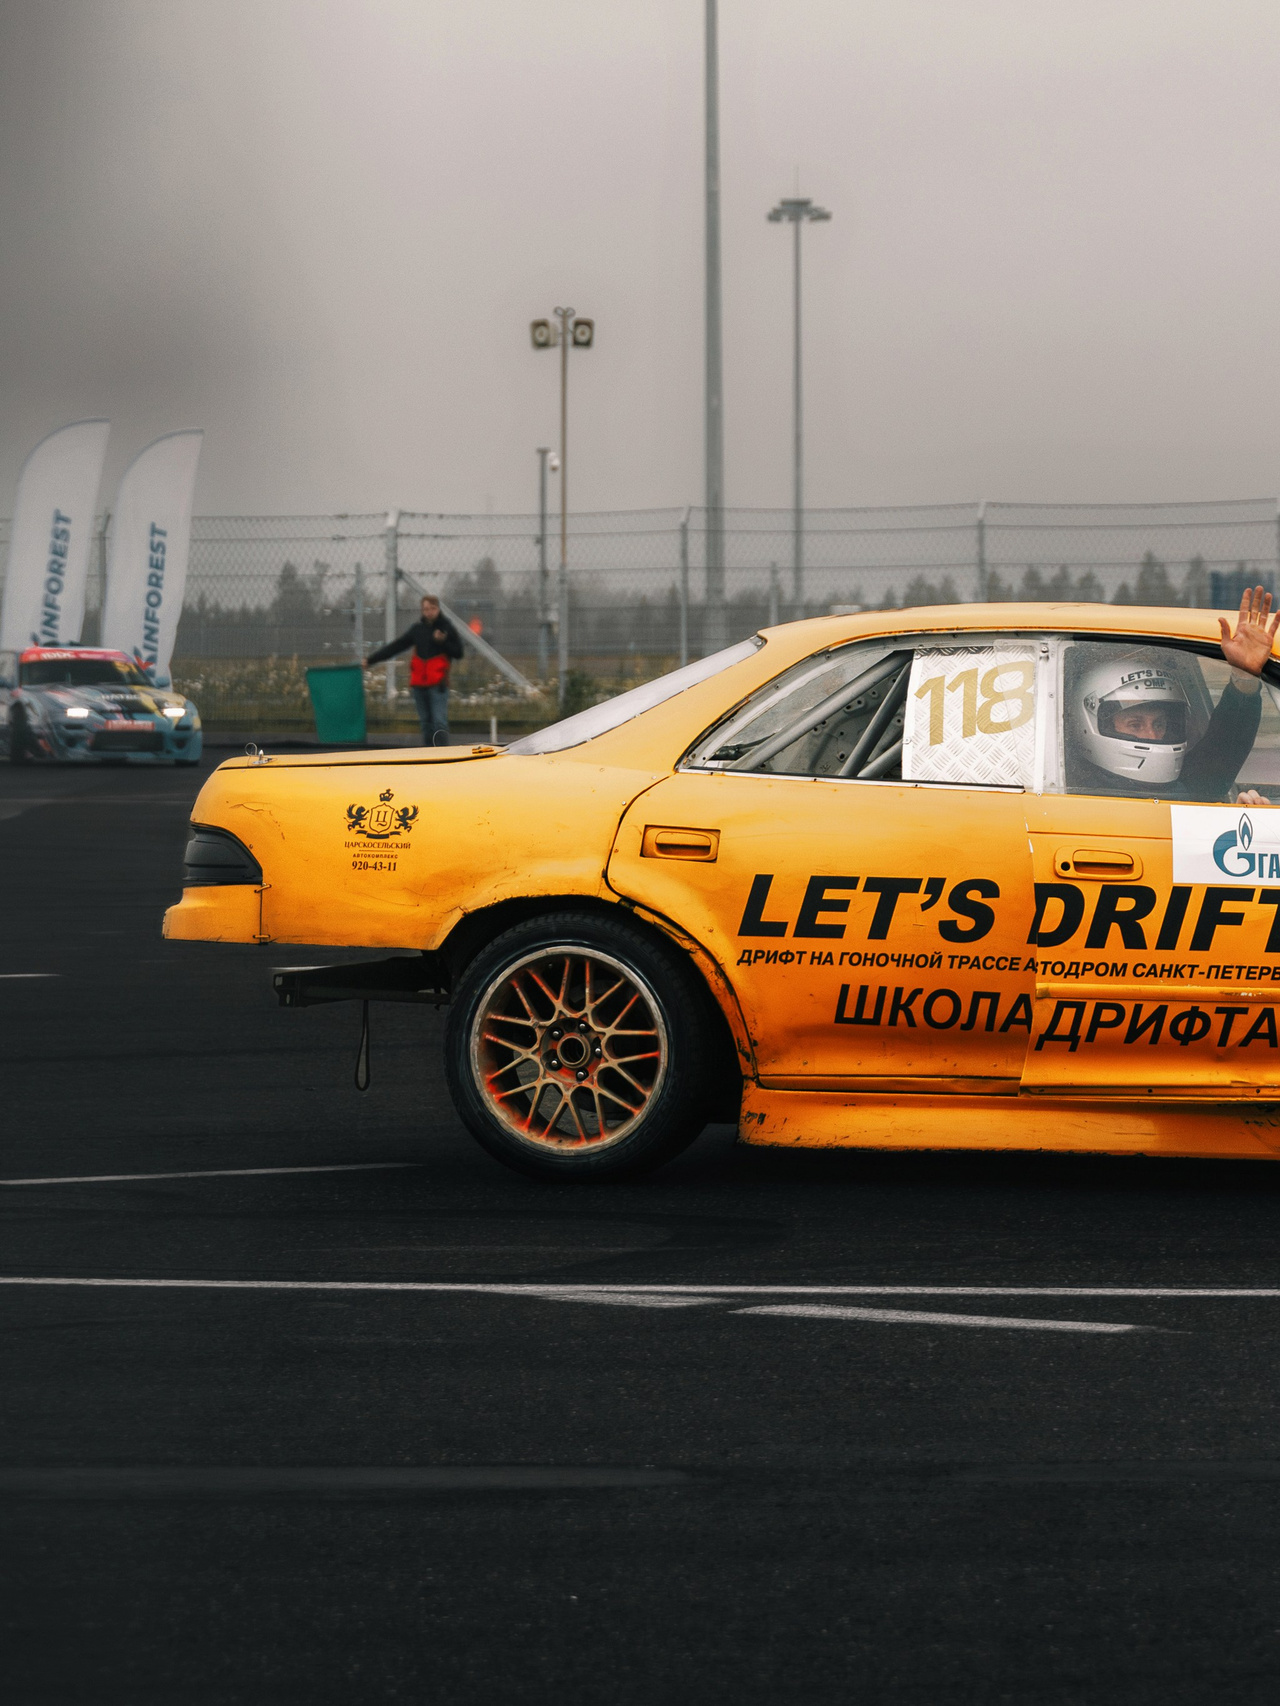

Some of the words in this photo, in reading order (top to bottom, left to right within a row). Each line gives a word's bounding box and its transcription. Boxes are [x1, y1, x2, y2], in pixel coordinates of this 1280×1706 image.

[1121, 669, 1153, 684] LET'S
[914, 660, 1036, 747] 118
[344, 841, 411, 849] ЦАРСКОСЕЛЬСКИЙ
[352, 861, 397, 871] 920-43-11
[737, 873, 1001, 944] LET'S
[737, 949, 807, 967] ДРИФТ
[809, 950, 835, 966] НА
[838, 951, 943, 969] ГОНОЧНОЙ
[947, 954, 1018, 972] ТРАССЕ
[834, 982, 1034, 1035] ШКОЛА
[1034, 999, 1280, 1053] ДРИФТА
